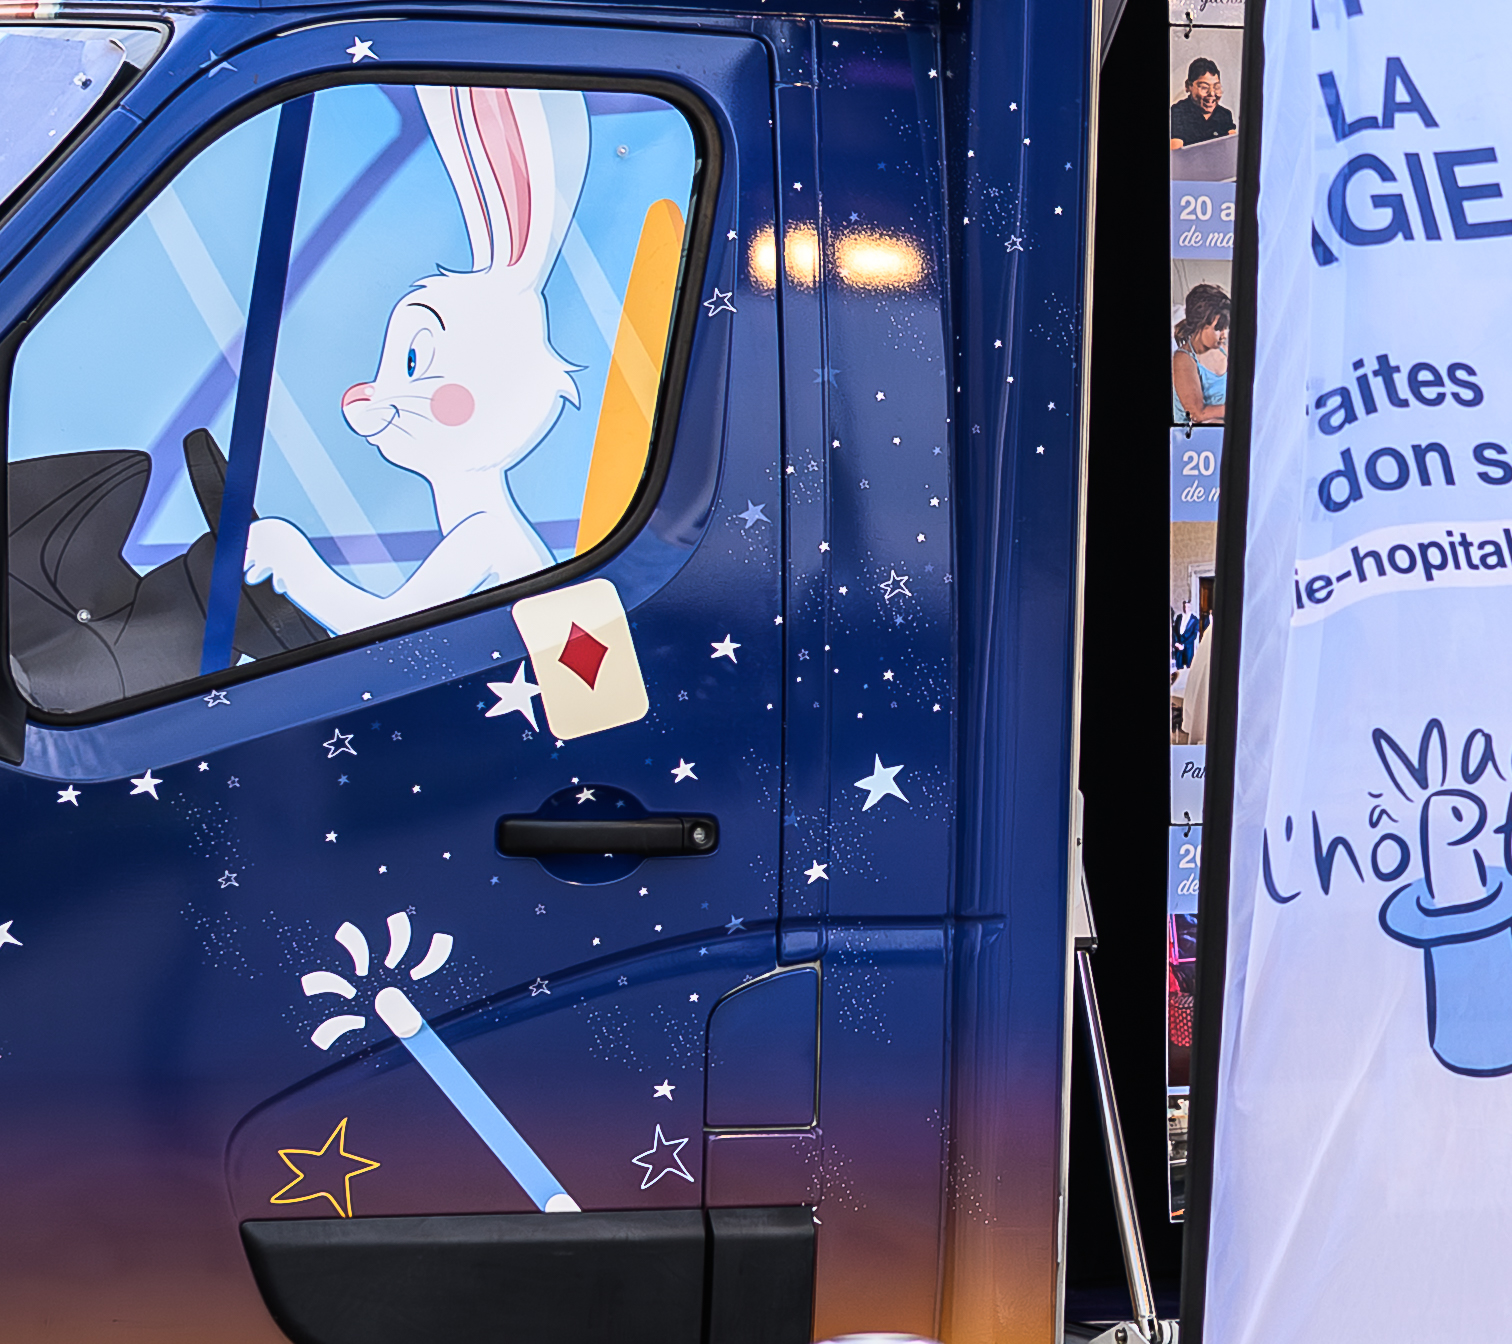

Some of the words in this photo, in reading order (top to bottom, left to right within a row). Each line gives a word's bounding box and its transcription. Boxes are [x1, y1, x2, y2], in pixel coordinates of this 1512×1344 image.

[1317, 57, 1440, 143] LA
[1180, 195, 1213, 221] 20
[1179, 225, 1203, 247] de
[1306, 353, 1485, 436] aites
[1182, 451, 1215, 476] 20
[1318, 441, 1457, 513] don
[1181, 480, 1205, 502] de
